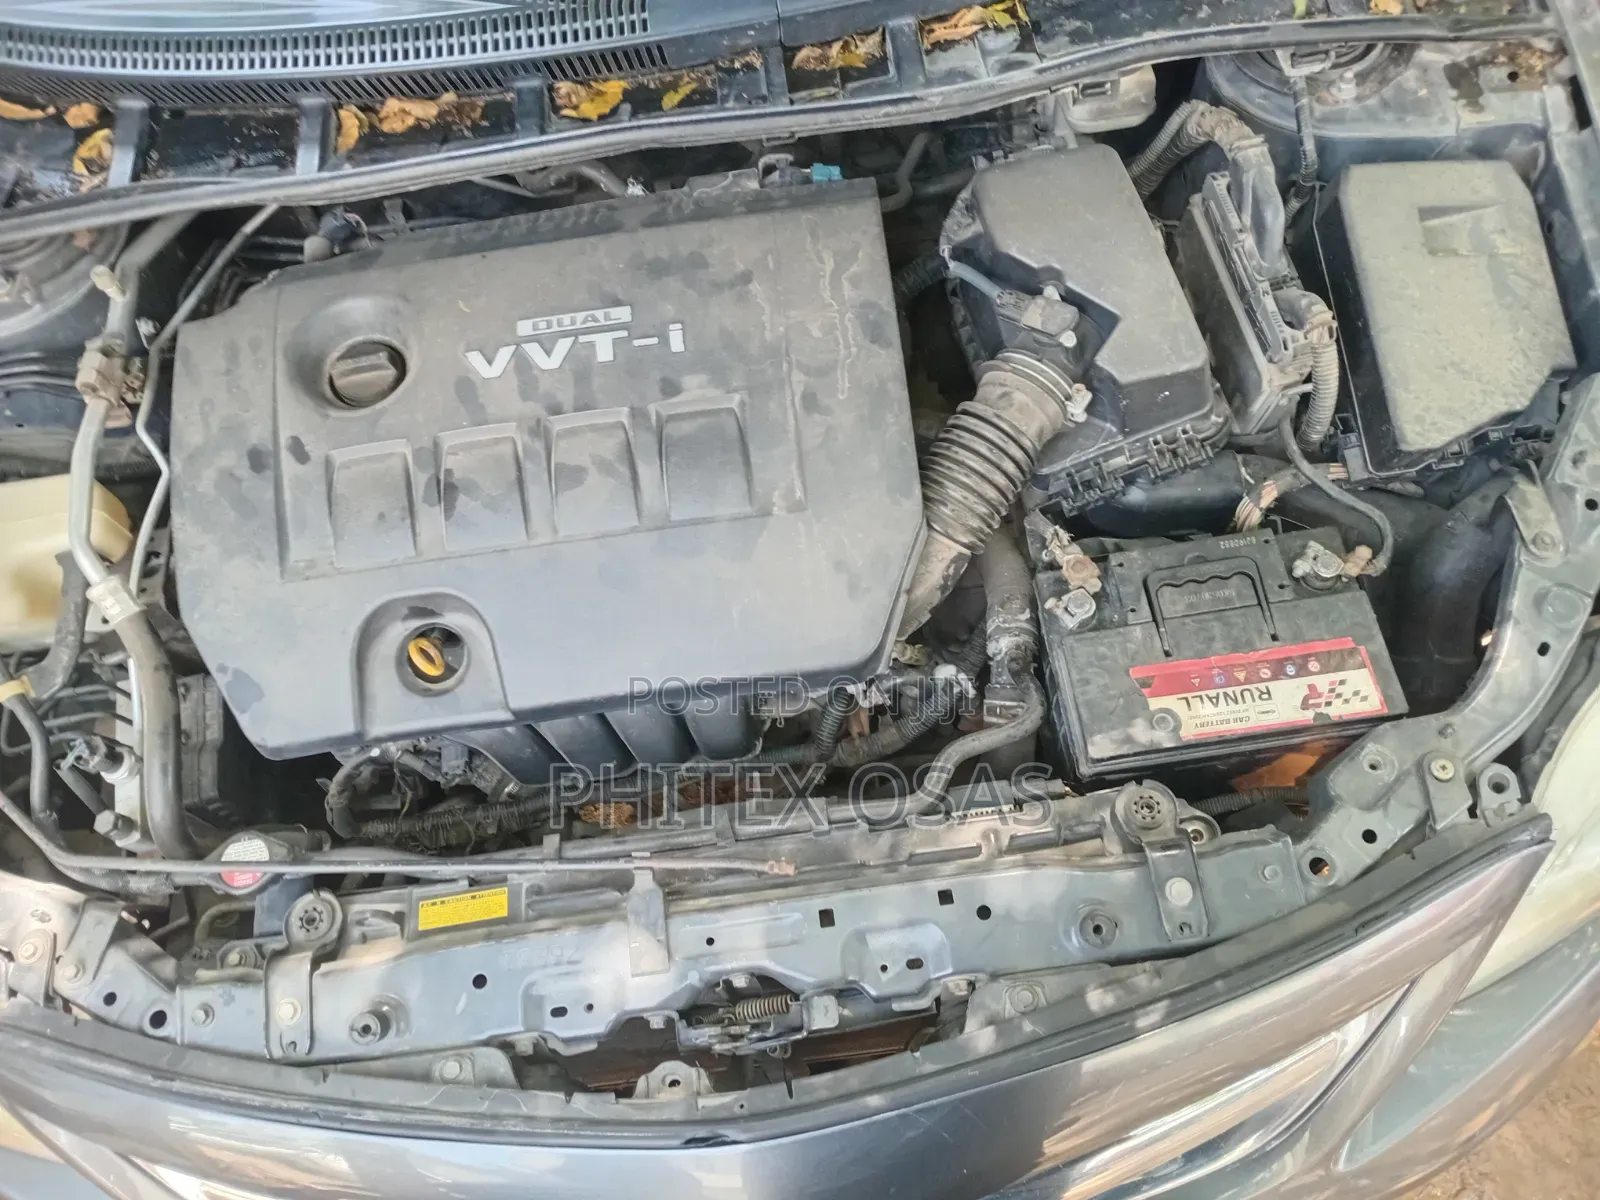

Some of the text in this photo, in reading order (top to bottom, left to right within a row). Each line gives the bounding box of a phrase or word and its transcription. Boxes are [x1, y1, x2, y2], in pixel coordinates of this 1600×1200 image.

[532, 310, 622, 332] DUAL
[465, 323, 685, 380] VVT-i
[1176, 685, 1273, 712] RUNALL
[1194, 715, 1251, 730] CAR BATTERY
